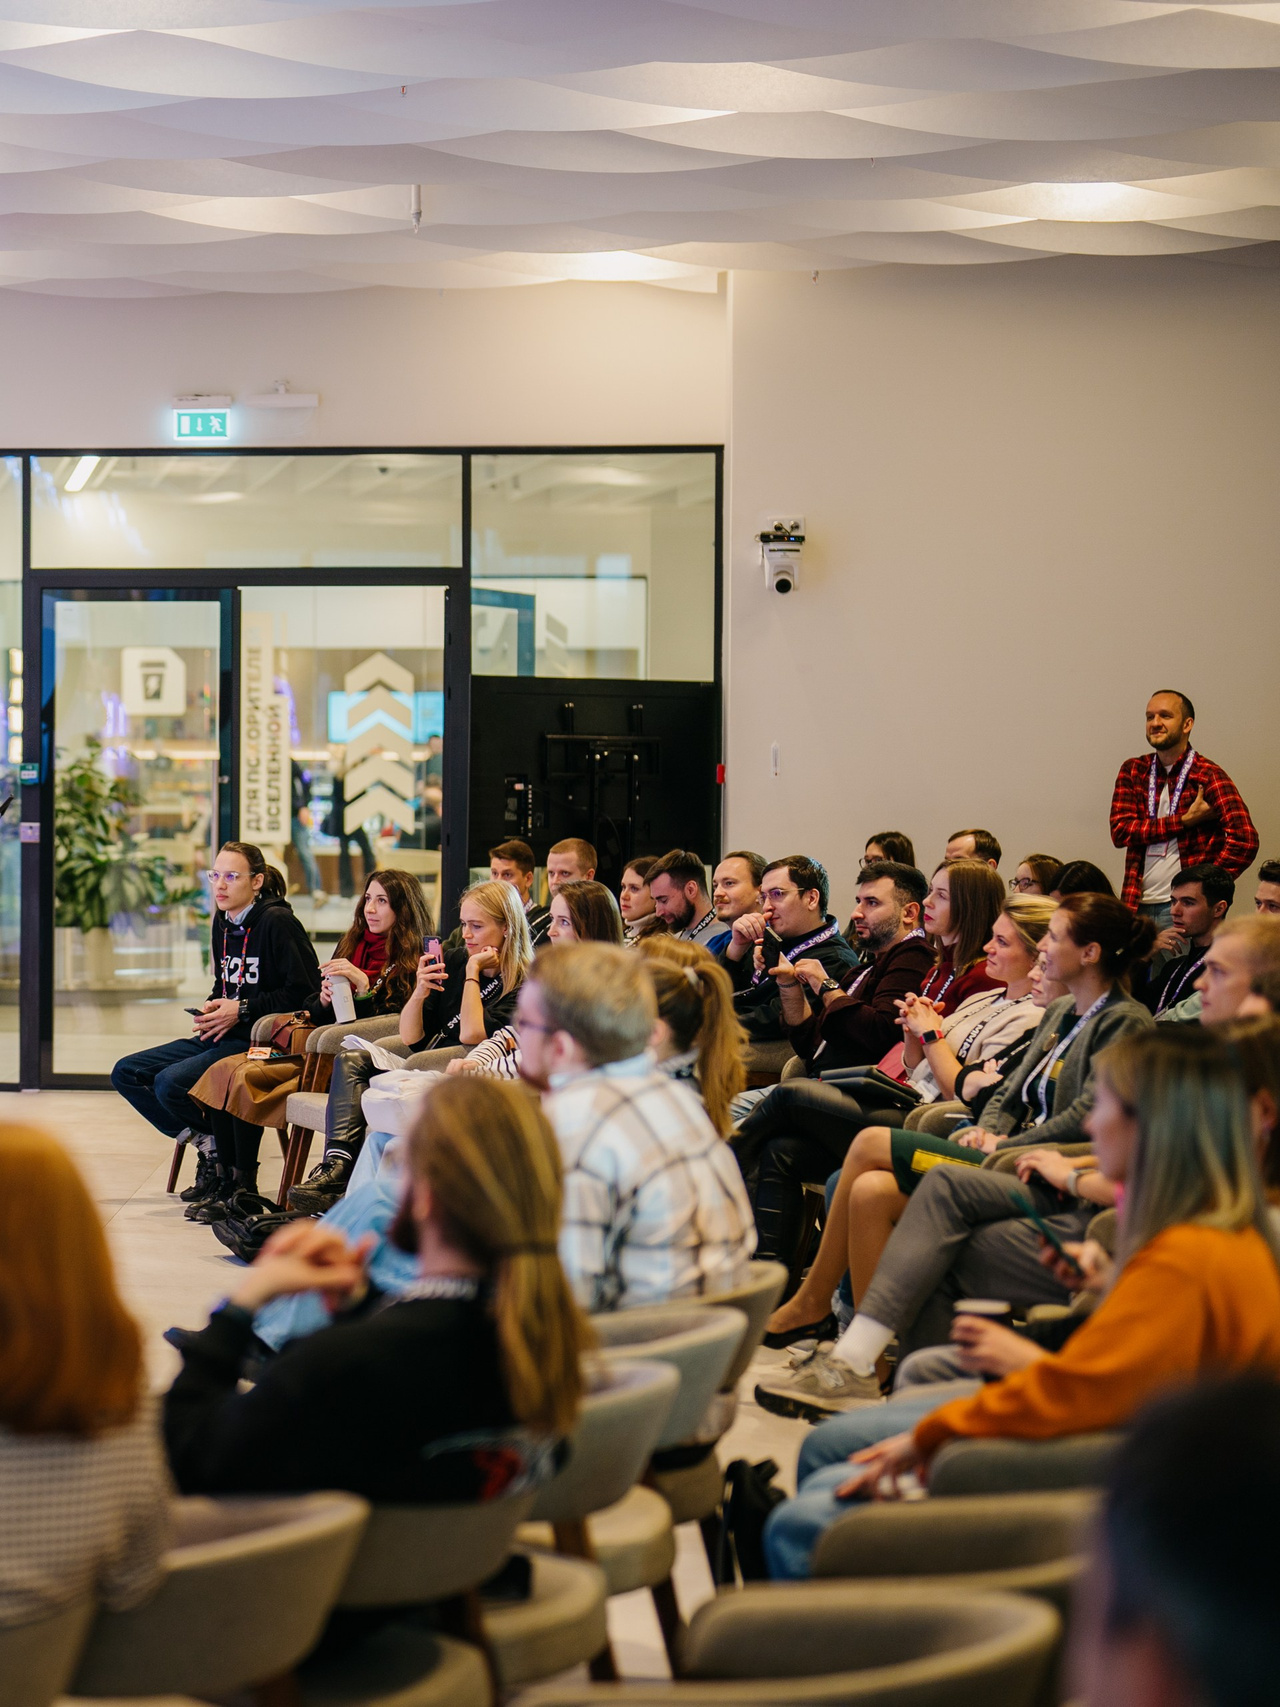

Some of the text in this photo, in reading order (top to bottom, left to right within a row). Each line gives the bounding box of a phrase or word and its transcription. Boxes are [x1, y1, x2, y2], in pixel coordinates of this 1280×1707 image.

[246, 628, 262, 833] ДЛЯ ПОКОРИТЕЛЕ
[265, 703, 282, 832] ВСЕЛЕННОЙ
